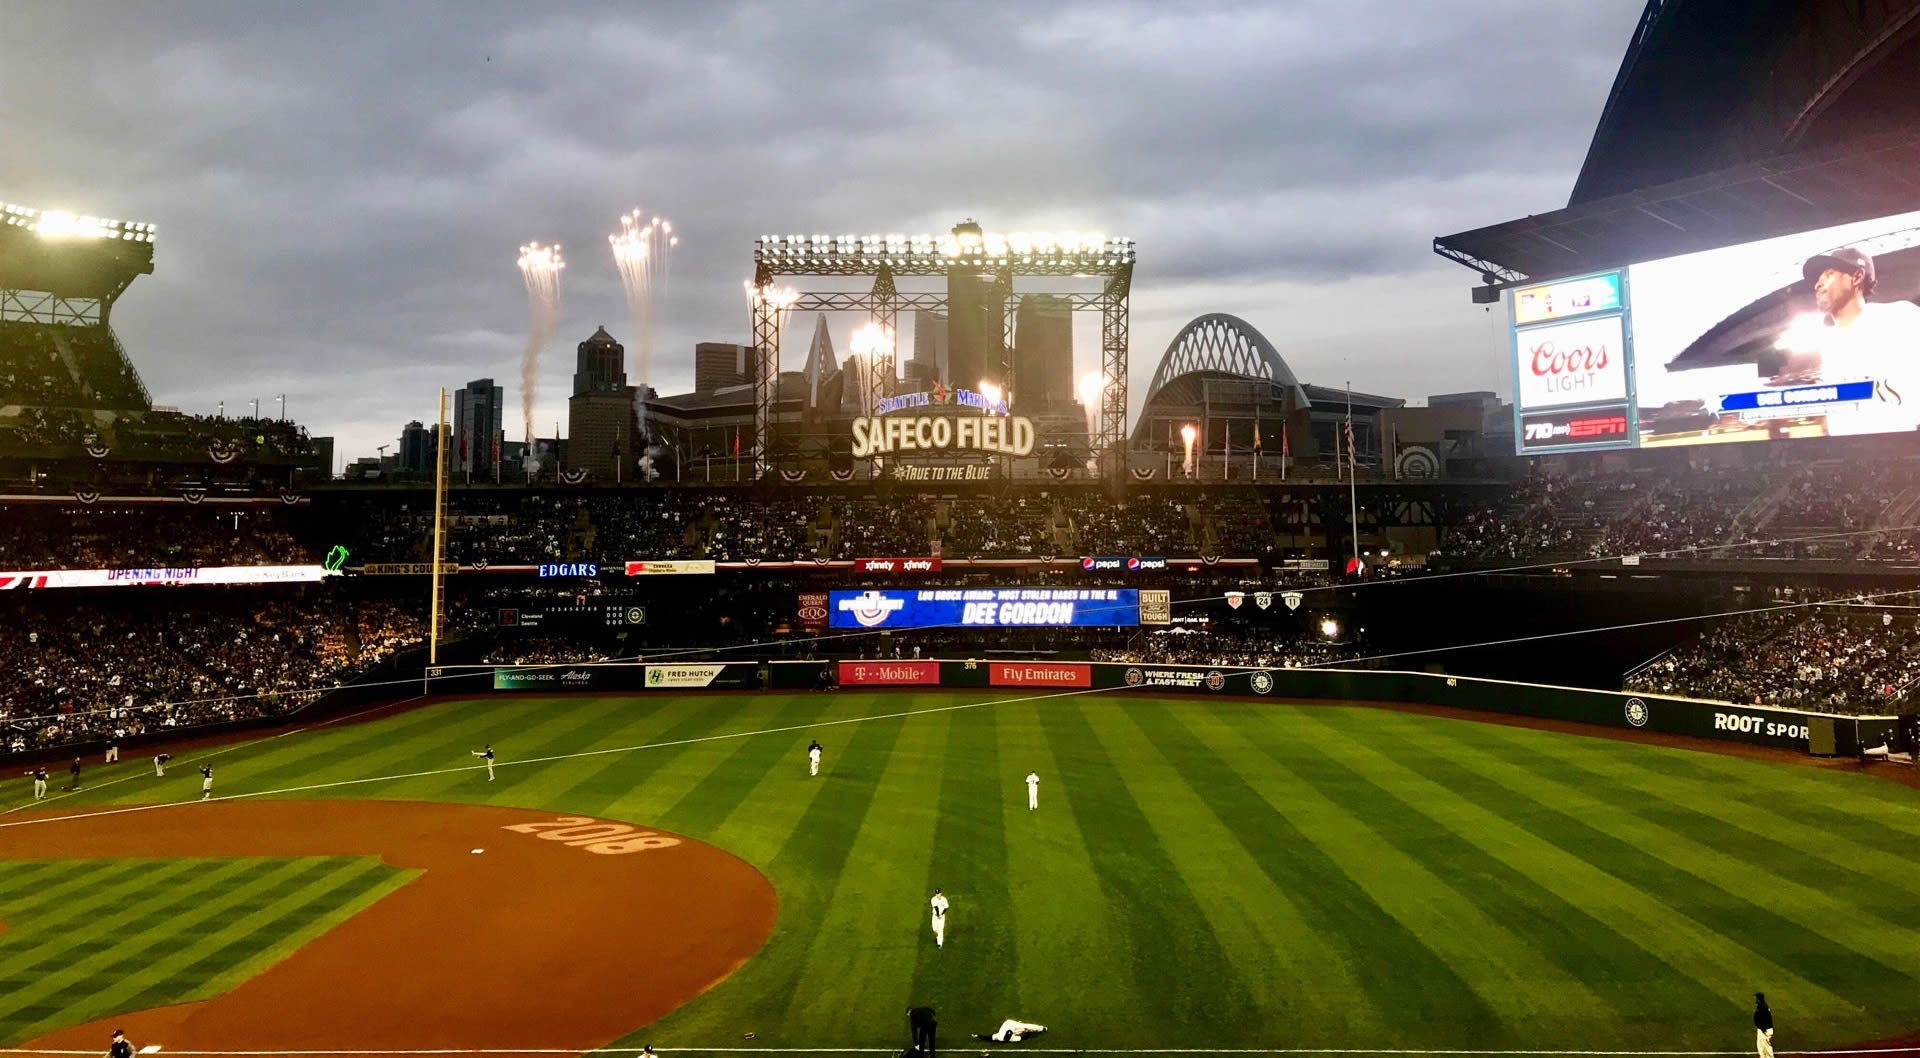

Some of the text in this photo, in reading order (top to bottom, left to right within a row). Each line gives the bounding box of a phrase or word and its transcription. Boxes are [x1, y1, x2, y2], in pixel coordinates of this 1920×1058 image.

[1530, 340, 1609, 377] Coors
[1546, 372, 1595, 393] LIGHT
[880, 388, 1009, 416] SEATTLE MARINS
[1524, 422, 1553, 440] 710
[1570, 417, 1626, 437] ESPN
[851, 416, 1035, 458] SAFECO FIELD
[905, 464, 991, 480] TRUE TO THE BLUE
[377, 564, 444, 574] KING'S COUT
[865, 560, 895, 572] xfinity
[903, 560, 932, 571] xfinity
[1096, 560, 1120, 570] pepsi
[1140, 560, 1165, 570] pepsi
[108, 567, 199, 581] OPENING NIGHT
[1142, 593, 1168, 603] BUILT
[1258, 597, 1269, 606] 24
[1288, 598, 1297, 606] 11
[962, 602, 1074, 624] DEE GORDON
[1143, 612, 1168, 621] TOUGH
[430, 669, 441, 677] 331
[560, 670, 591, 680] Alaska
[1003, 668, 1077, 682] Fly Emirates
[1144, 670, 1176, 679] WHERE
[1176, 671, 1204, 680] FRESH
[1176, 679, 1202, 687] MEET
[1714, 712, 1810, 740] ROOT SPOR
[499, 816, 682, 855] 2018
